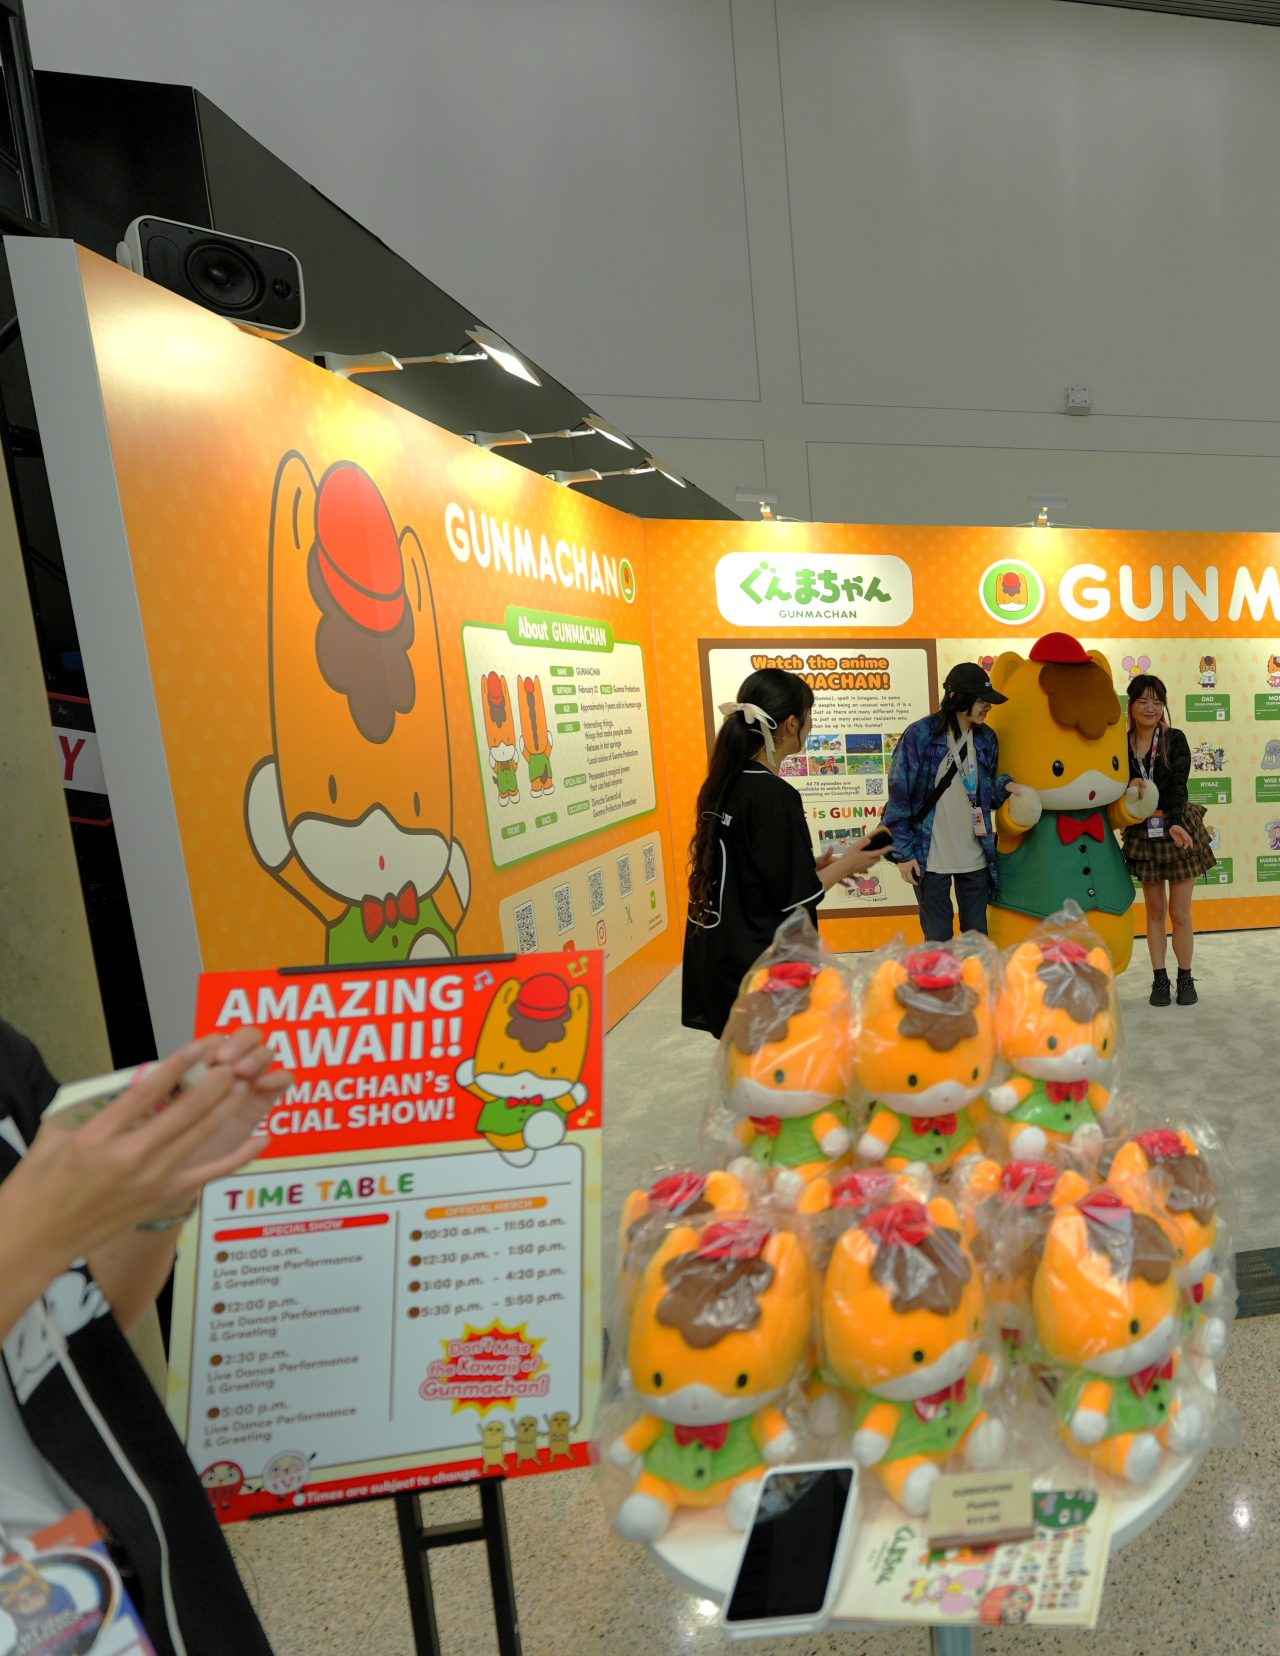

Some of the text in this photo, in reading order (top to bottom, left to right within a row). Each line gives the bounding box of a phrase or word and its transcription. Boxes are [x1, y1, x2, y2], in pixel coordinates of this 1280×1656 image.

[445, 502, 619, 598] GUNMACHAN
[739, 561, 892, 605] ぐんまちゃん
[779, 609, 857, 619] GUNMACHAN
[518, 616, 607, 647] About GUNMACHAN
[751, 654, 889, 670] Watch the anime
[799, 672, 890, 691] MACHAN!
[58, 735, 86, 781] Y
[812, 807, 826, 819] is
[215, 974, 466, 1027] AMAZING
[265, 1017, 463, 1070] AWAII!!
[251, 1097, 456, 1137] ECIAL SHOW!
[224, 1172, 415, 1211] TIME TABLE
[444, 1200, 534, 1217] OFFICIAL MERCH
[261, 1219, 344, 1238] SPECIAL SHOW
[424, 1217, 565, 1240] 10:30 a.m. 11:50 a.m.
[229, 1246, 301, 1261] 10:00 a.m.
[423, 1242, 565, 1265] 12:30 p.m. 1:50 p.m.
[213, 1254, 363, 1279] Live Dance Performance
[212, 1275, 280, 1291] & Greeting
[422, 1267, 565, 1291] 3:00 p.m. 4:20 p.m.
[226, 1297, 298, 1313] 12:00 p.m.
[454, 1302, 483, 1316] p.m.
[537, 1292, 565, 1305] p.m.
[209, 1305, 361, 1331] Live Dance Performance
[209, 1327, 277, 1343] & Greeting
[224, 1350, 289, 1365] 2:30 p.m.
[494, 1339, 531, 1355] Miss
[207, 1355, 359, 1383] Live Dance Performance
[428, 1356, 542, 1377] the Kawaii of
[206, 1379, 275, 1395] & Greeting
[421, 1375, 549, 1399] Gunmachan!
[257, 1401, 289, 1416] p.m.
[204, 1407, 357, 1436] Live Dance Performance
[203, 1432, 272, 1449] & Greeting
[307, 1469, 481, 1503] Times are subject to change.
